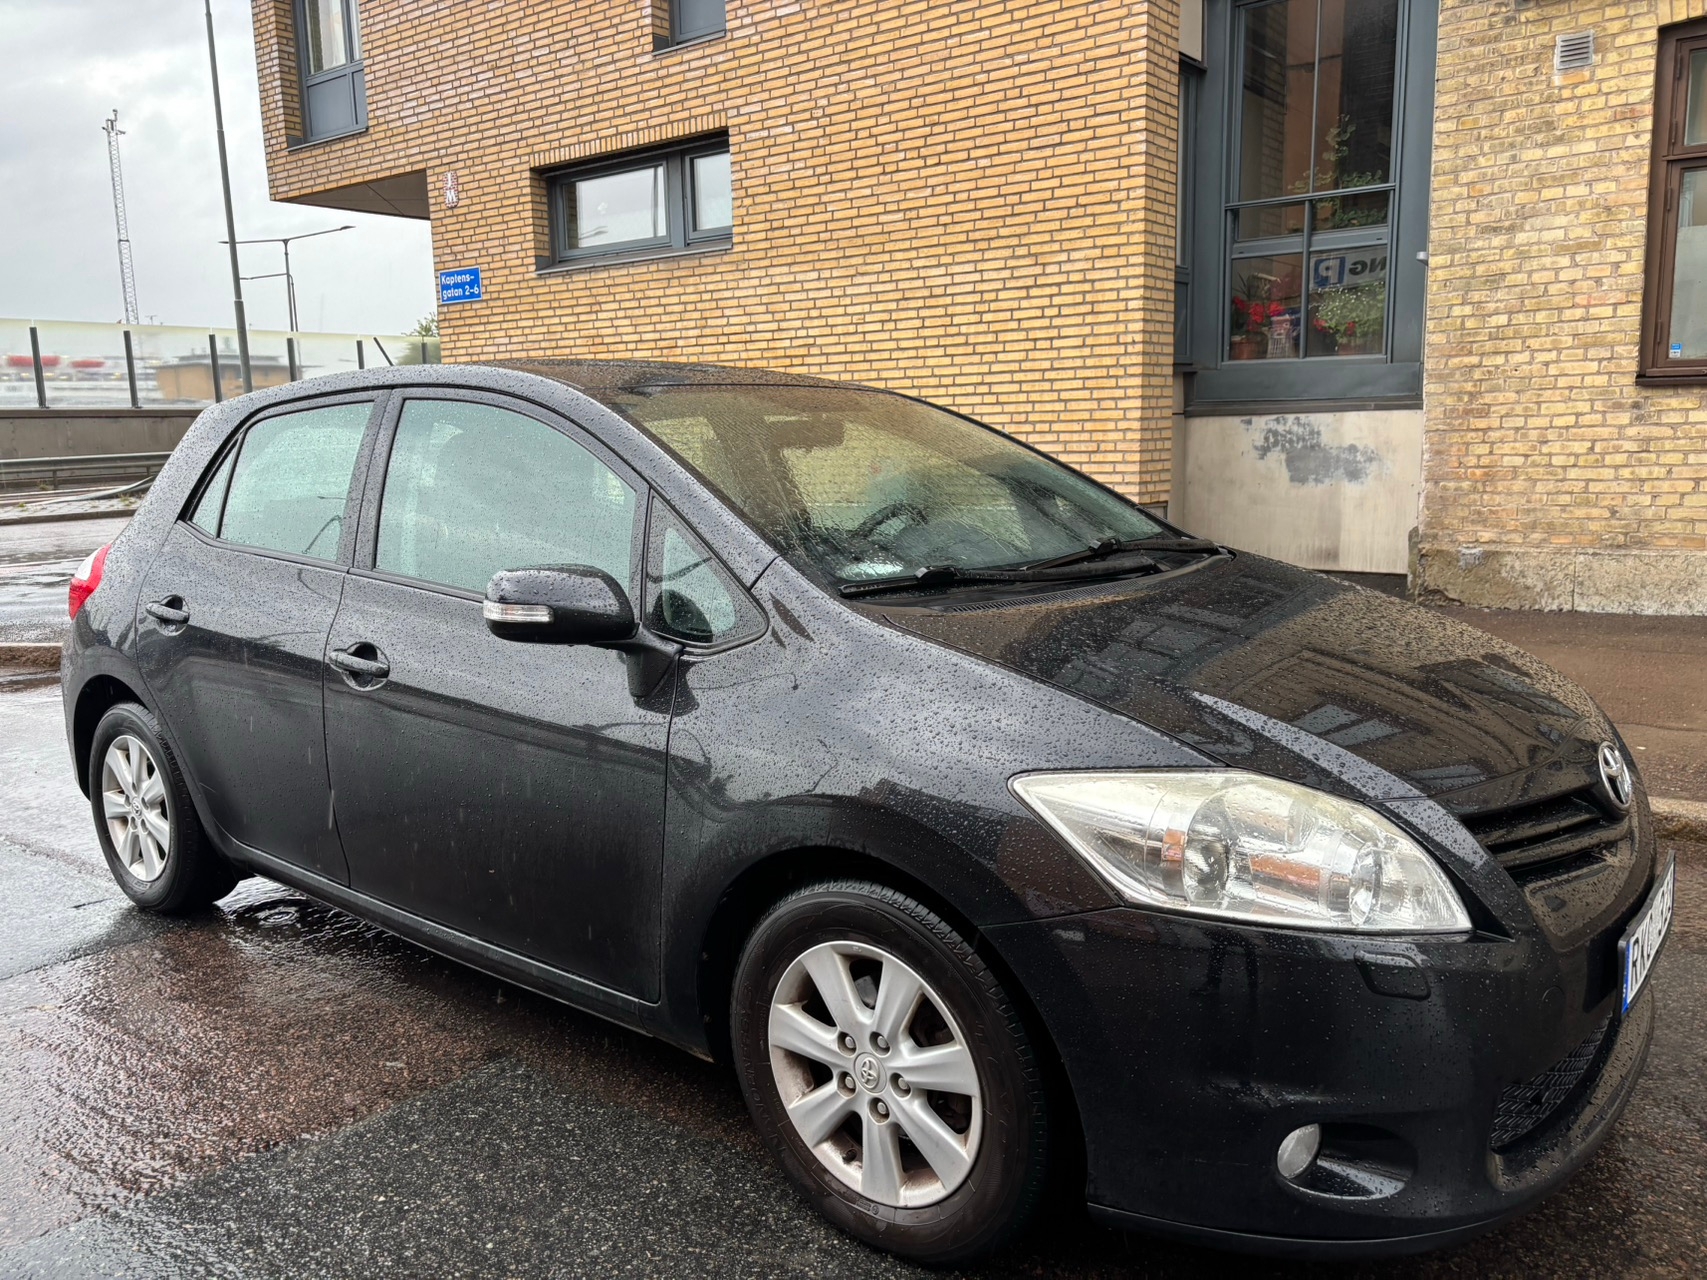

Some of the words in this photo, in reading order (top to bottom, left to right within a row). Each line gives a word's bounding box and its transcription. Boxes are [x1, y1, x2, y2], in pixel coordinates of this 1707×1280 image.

[441, 273, 475, 286] Kaptens-
[442, 287, 463, 300] gatan
[464, 283, 480, 295] 2-6
